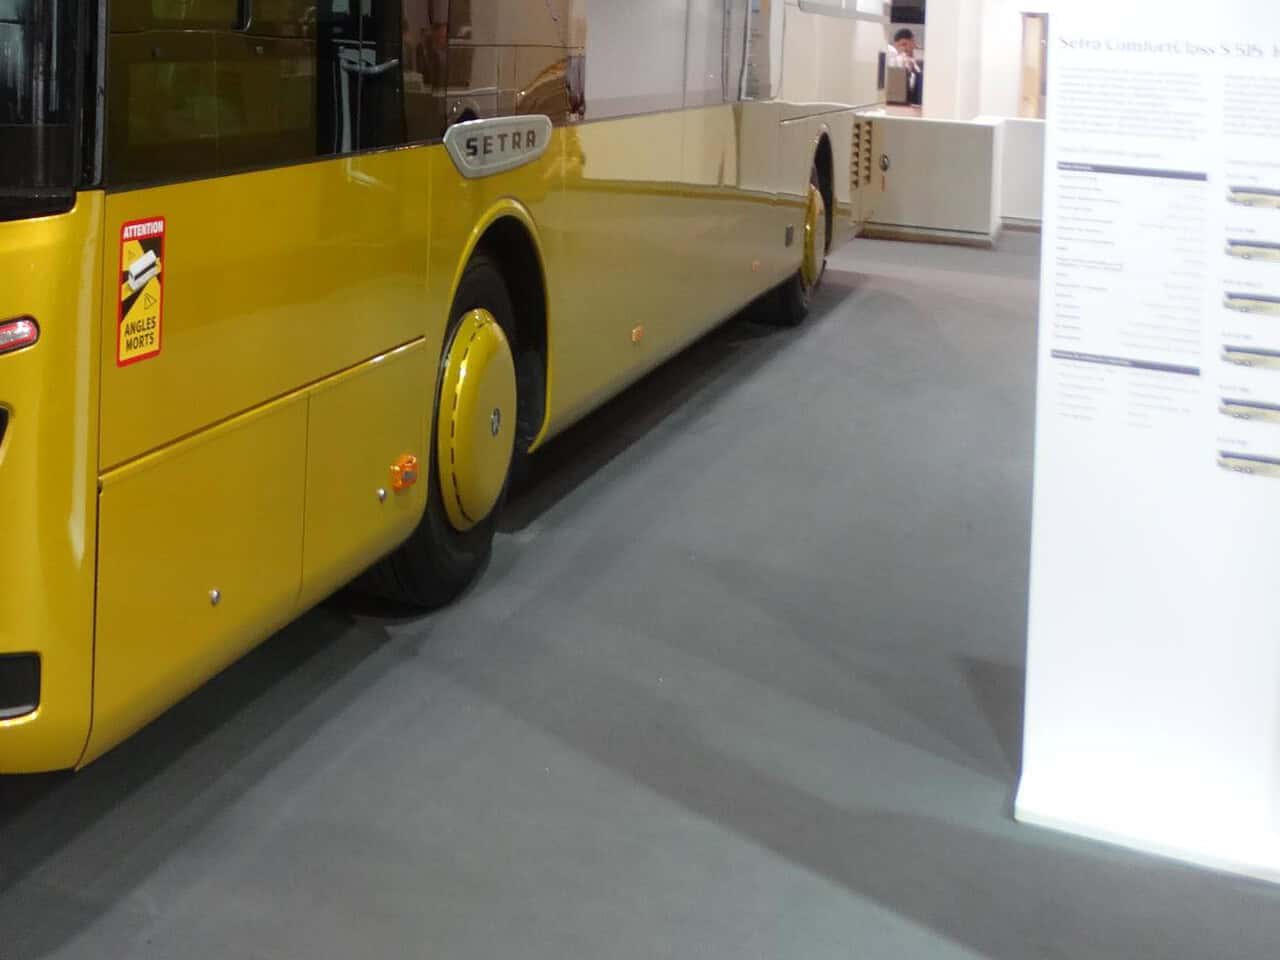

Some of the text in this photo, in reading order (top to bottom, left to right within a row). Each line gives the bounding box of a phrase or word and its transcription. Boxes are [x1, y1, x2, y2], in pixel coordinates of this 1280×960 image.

[1058, 35, 1102, 52] Setra
[465, 129, 537, 157] SETRA
[122, 220, 164, 240] ATTENTION
[124, 315, 157, 335] ANGLES
[125, 332, 155, 352] MORTS
